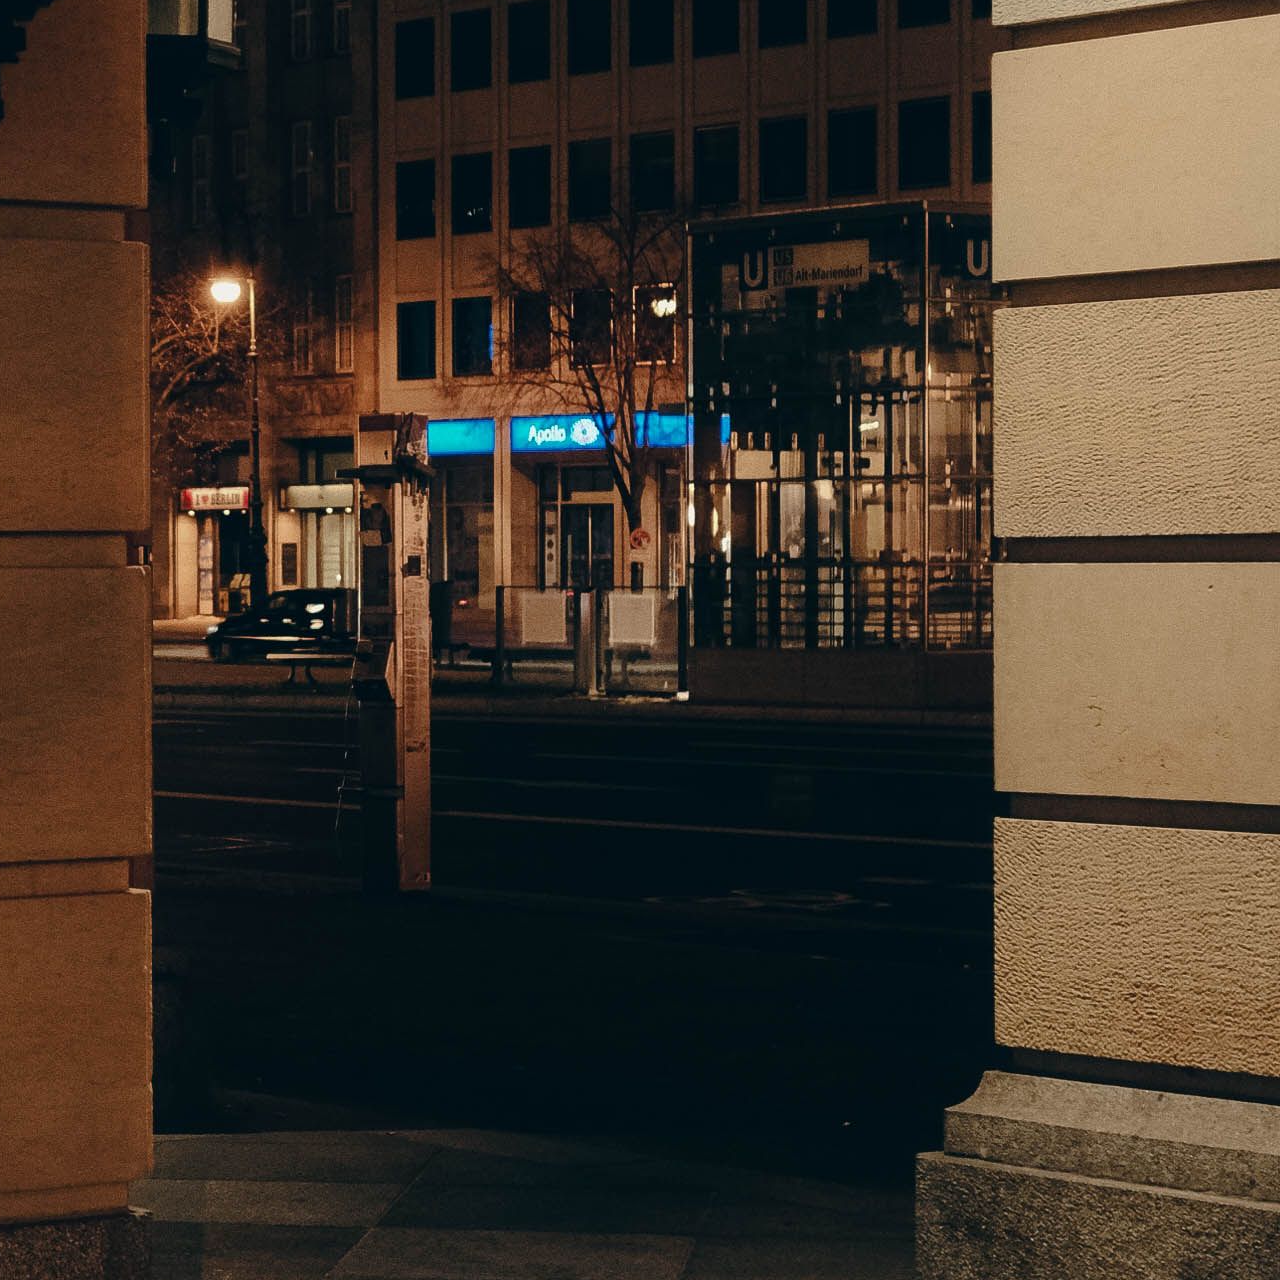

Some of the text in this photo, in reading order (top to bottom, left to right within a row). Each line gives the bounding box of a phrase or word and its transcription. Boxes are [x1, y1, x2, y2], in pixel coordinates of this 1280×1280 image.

[744, 249, 763, 287] U
[966, 240, 988, 276] U
[796, 263, 862, 280] Alt-Mariendorf
[528, 424, 566, 445] Apollo
[211, 493, 240, 504] BERLIN
